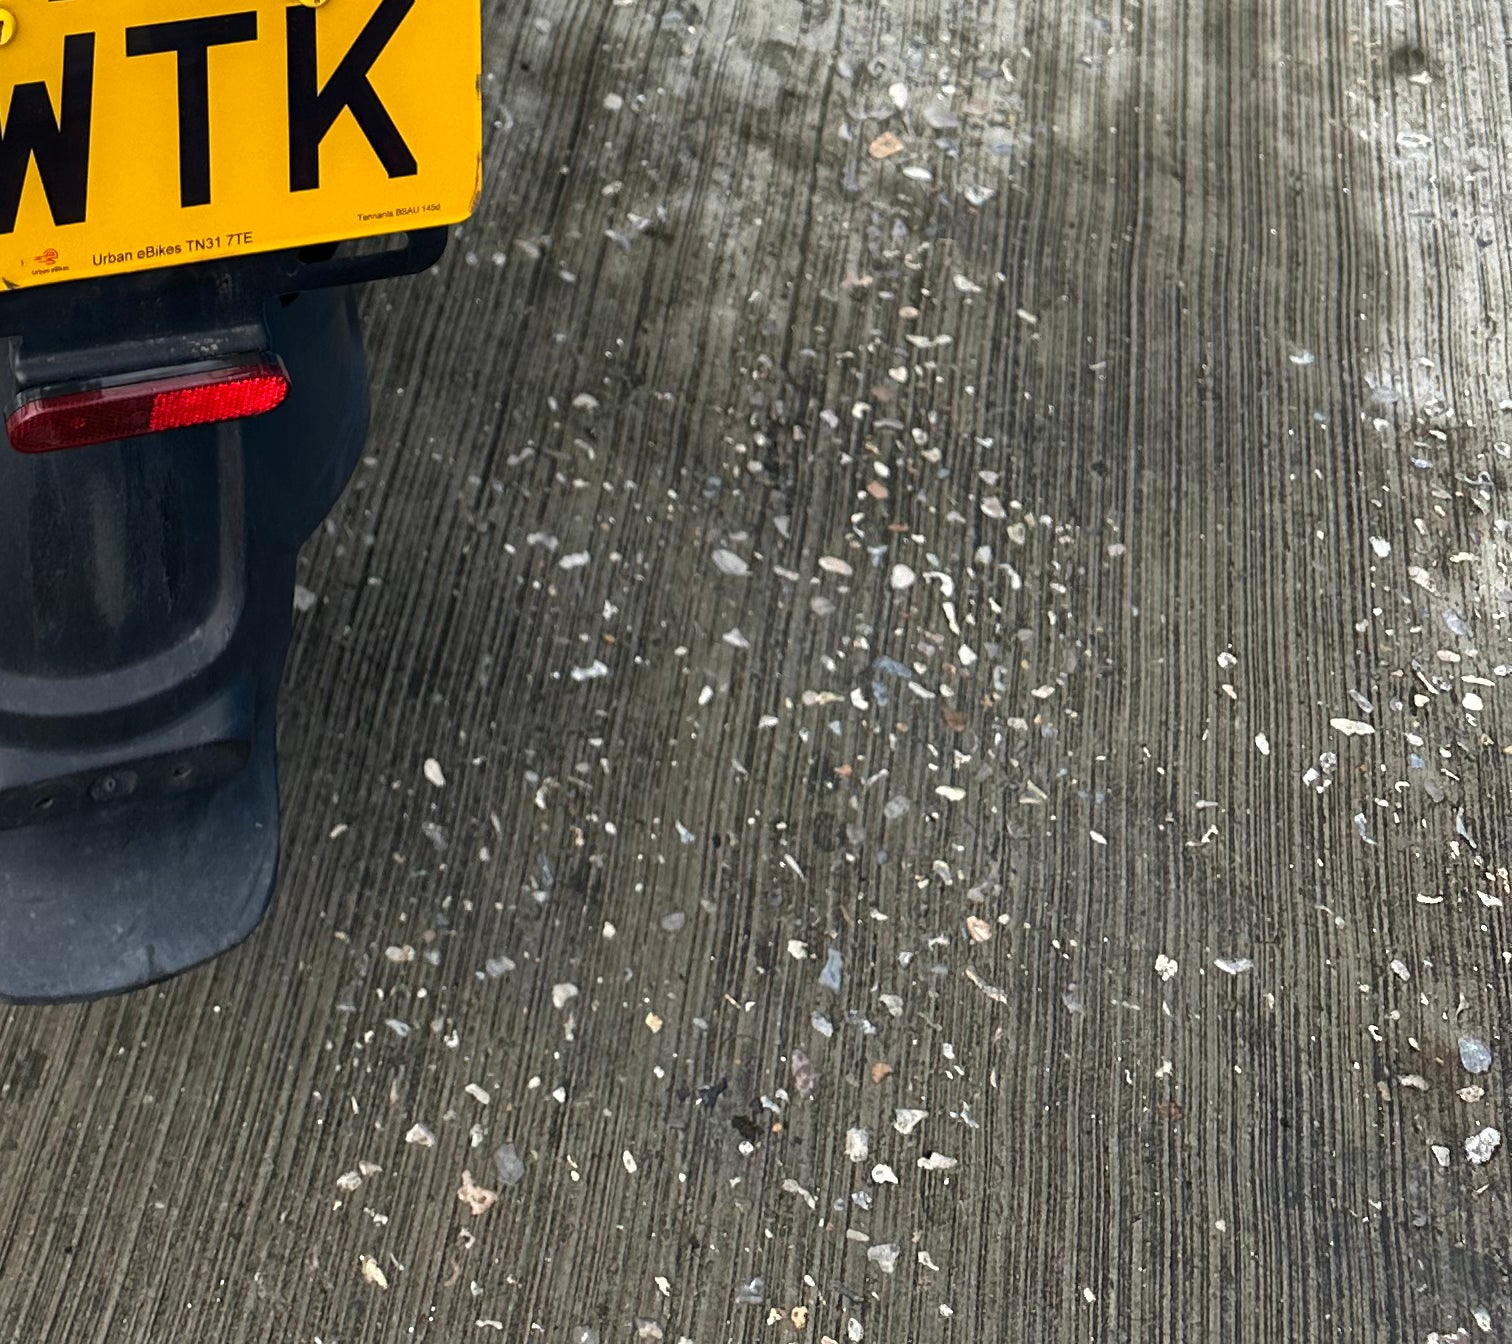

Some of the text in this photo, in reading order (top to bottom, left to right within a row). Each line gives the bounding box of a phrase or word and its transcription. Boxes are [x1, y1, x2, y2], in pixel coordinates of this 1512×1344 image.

[92, 231, 254, 266] Urban eBikes TN31 7TE
